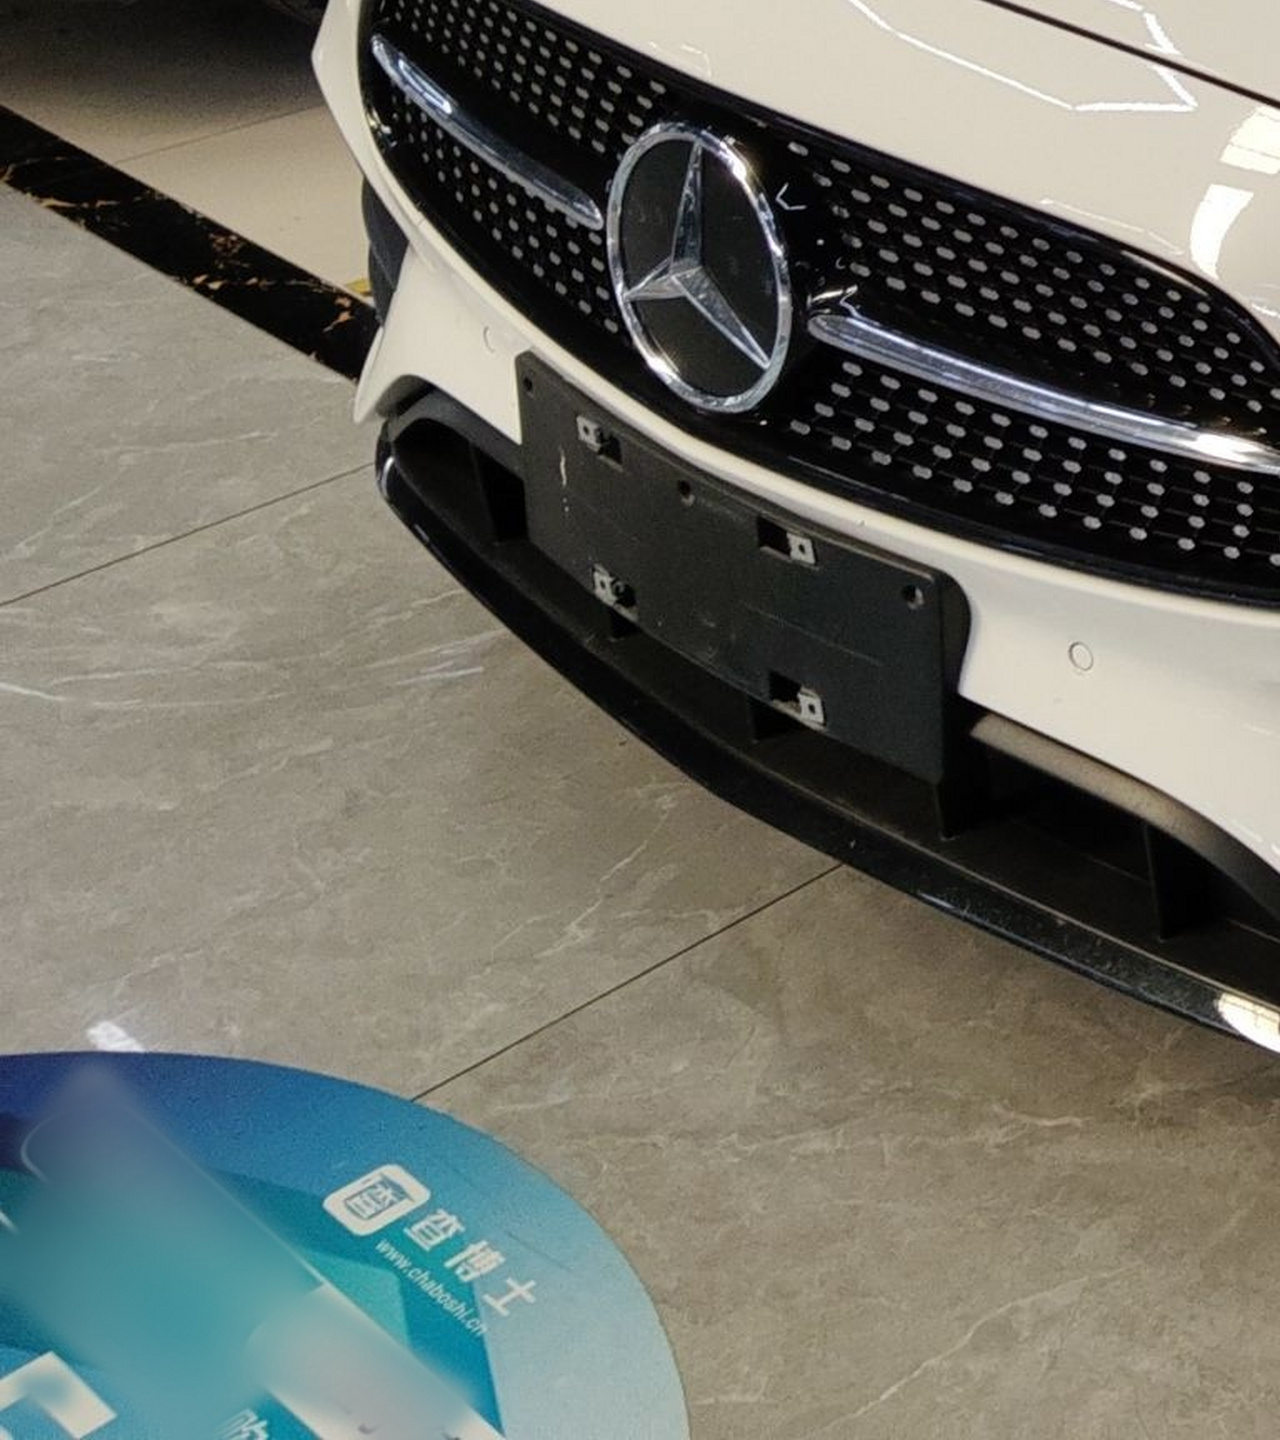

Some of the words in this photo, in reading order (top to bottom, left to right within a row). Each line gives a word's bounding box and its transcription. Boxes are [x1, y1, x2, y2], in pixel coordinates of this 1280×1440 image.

[375, 1238, 488, 1338] www.chaboshi.cn
[403, 1208, 537, 1317] 查博士
